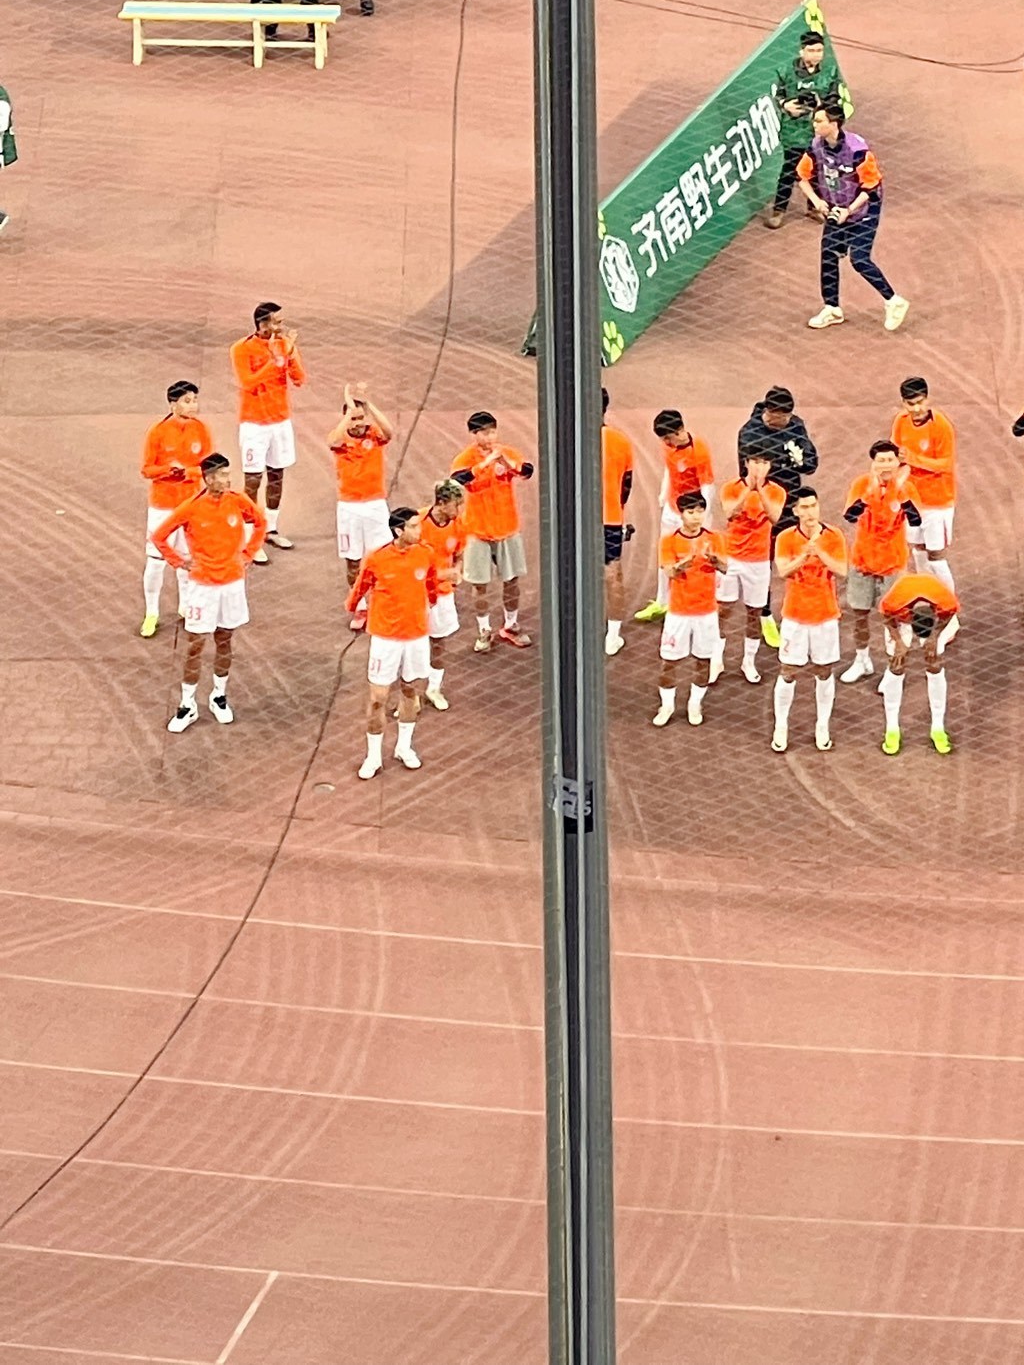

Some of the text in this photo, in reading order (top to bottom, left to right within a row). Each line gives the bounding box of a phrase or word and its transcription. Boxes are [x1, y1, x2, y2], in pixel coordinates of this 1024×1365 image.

[630, 85, 782, 278] 济南野生动物
